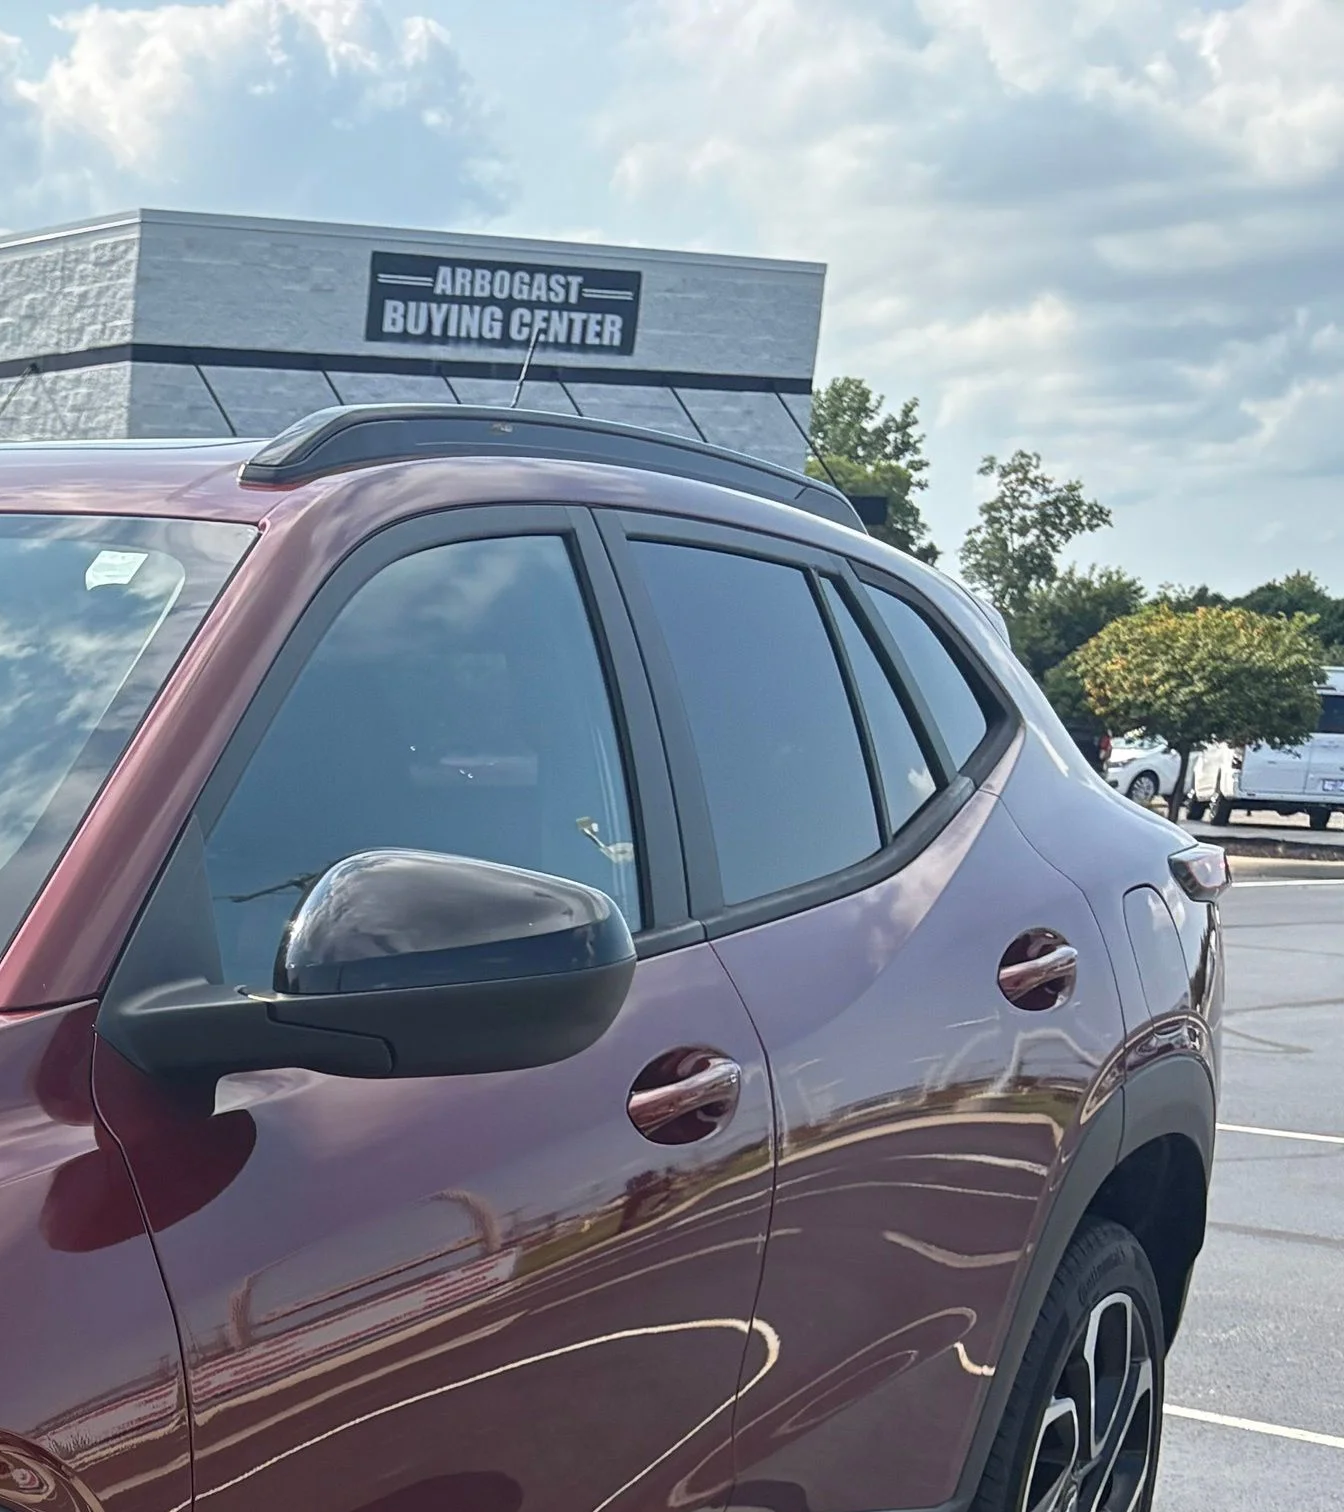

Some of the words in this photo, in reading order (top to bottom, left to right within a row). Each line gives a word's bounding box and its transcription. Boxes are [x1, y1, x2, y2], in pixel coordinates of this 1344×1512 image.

[433, 265, 584, 304] ARBOGAST
[382, 299, 503, 340] BUYING
[509, 307, 624, 347] CENTER
